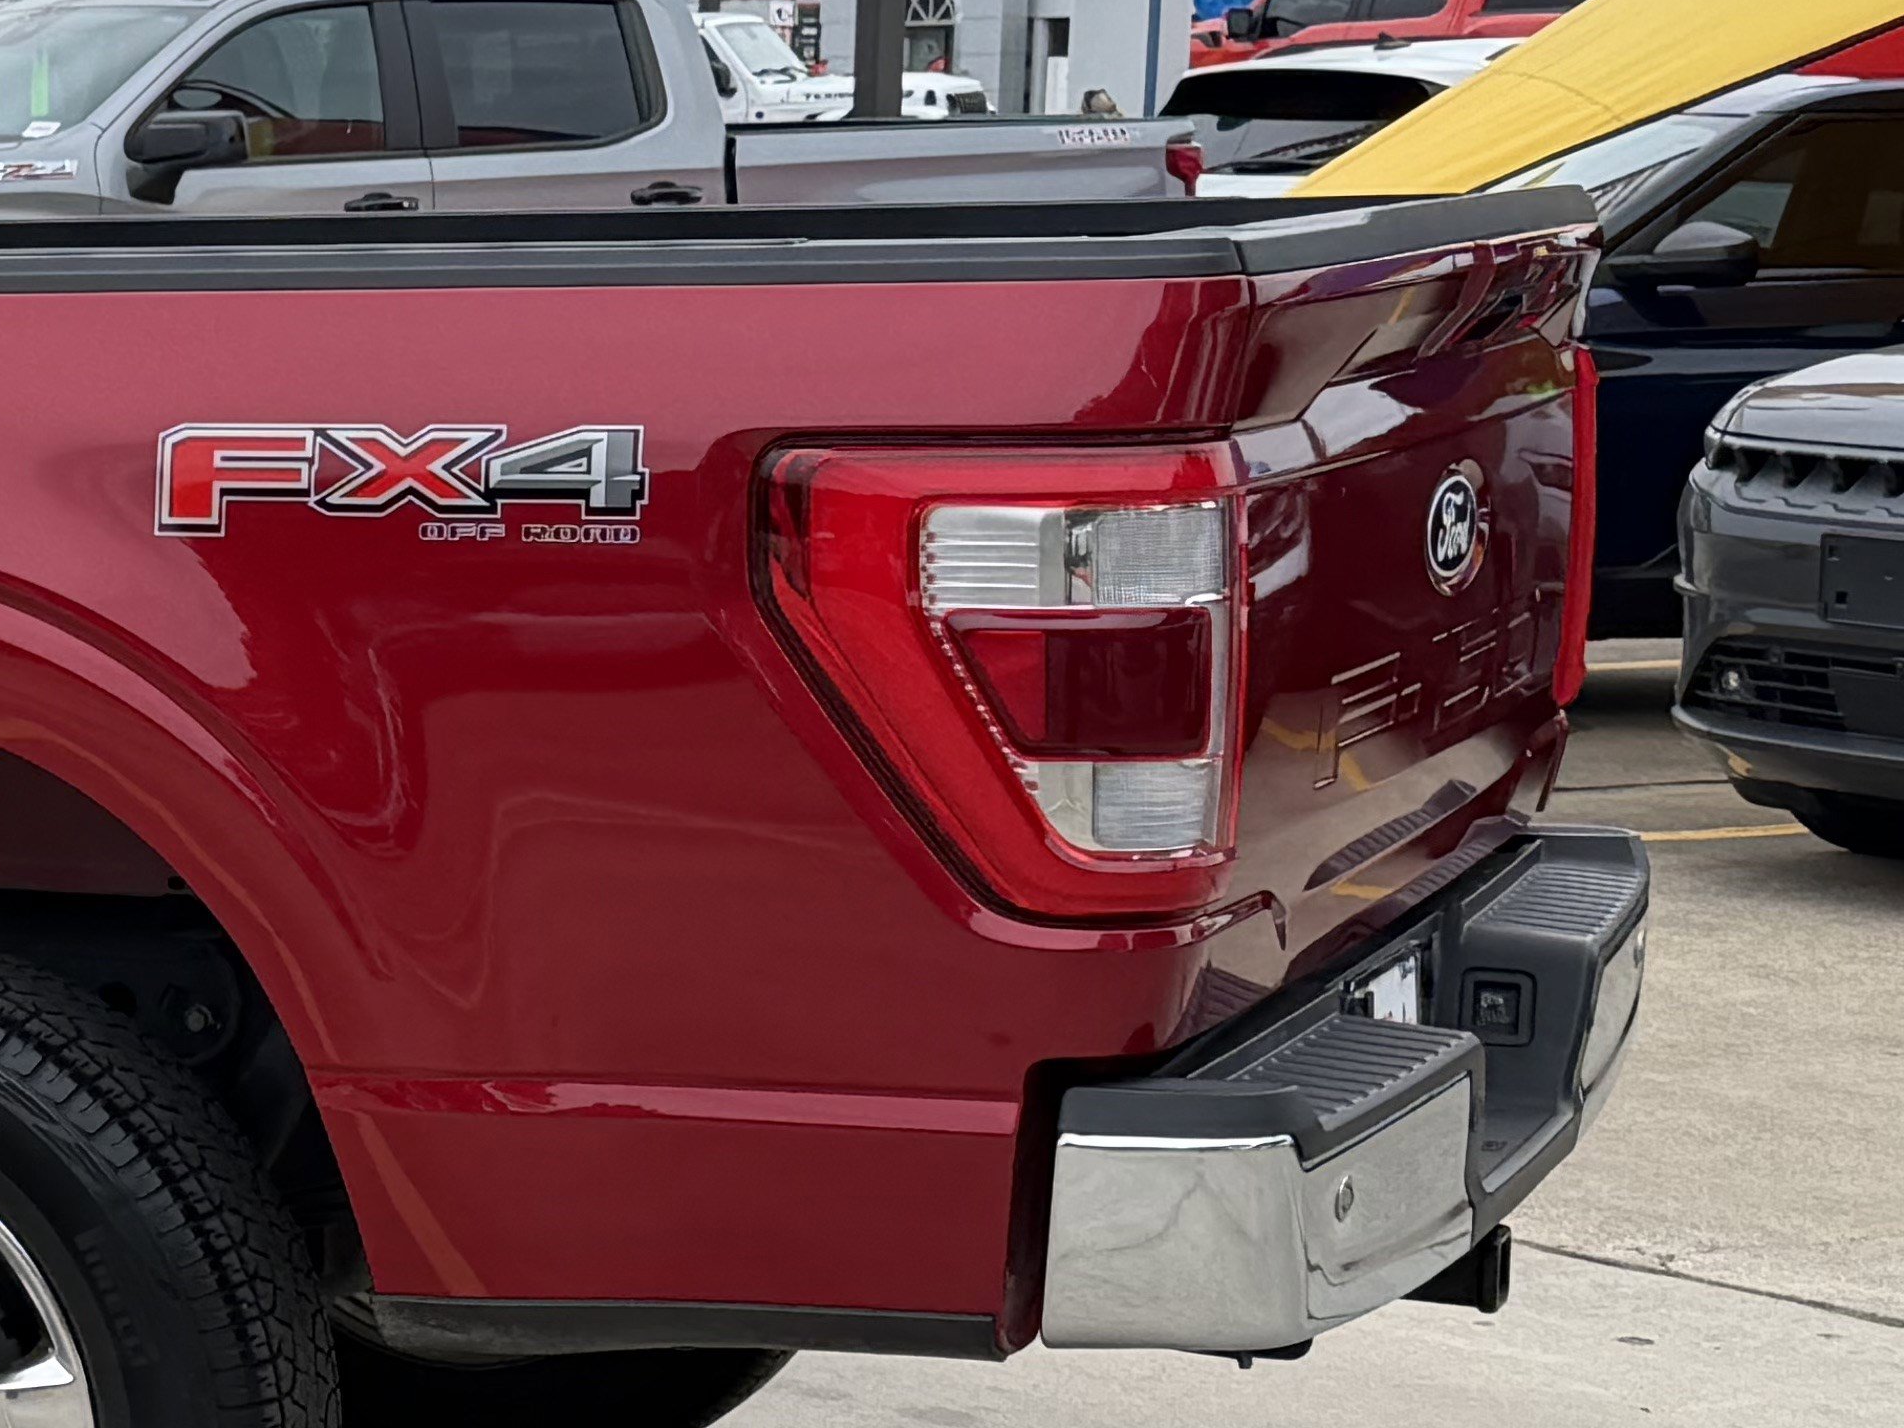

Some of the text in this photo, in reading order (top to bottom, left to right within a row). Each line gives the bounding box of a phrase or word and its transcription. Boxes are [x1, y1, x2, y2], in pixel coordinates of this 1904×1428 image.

[154, 423, 650, 537] FX4
[418, 522, 641, 544] OFF ROAD
[1437, 491, 1472, 563] Ford
